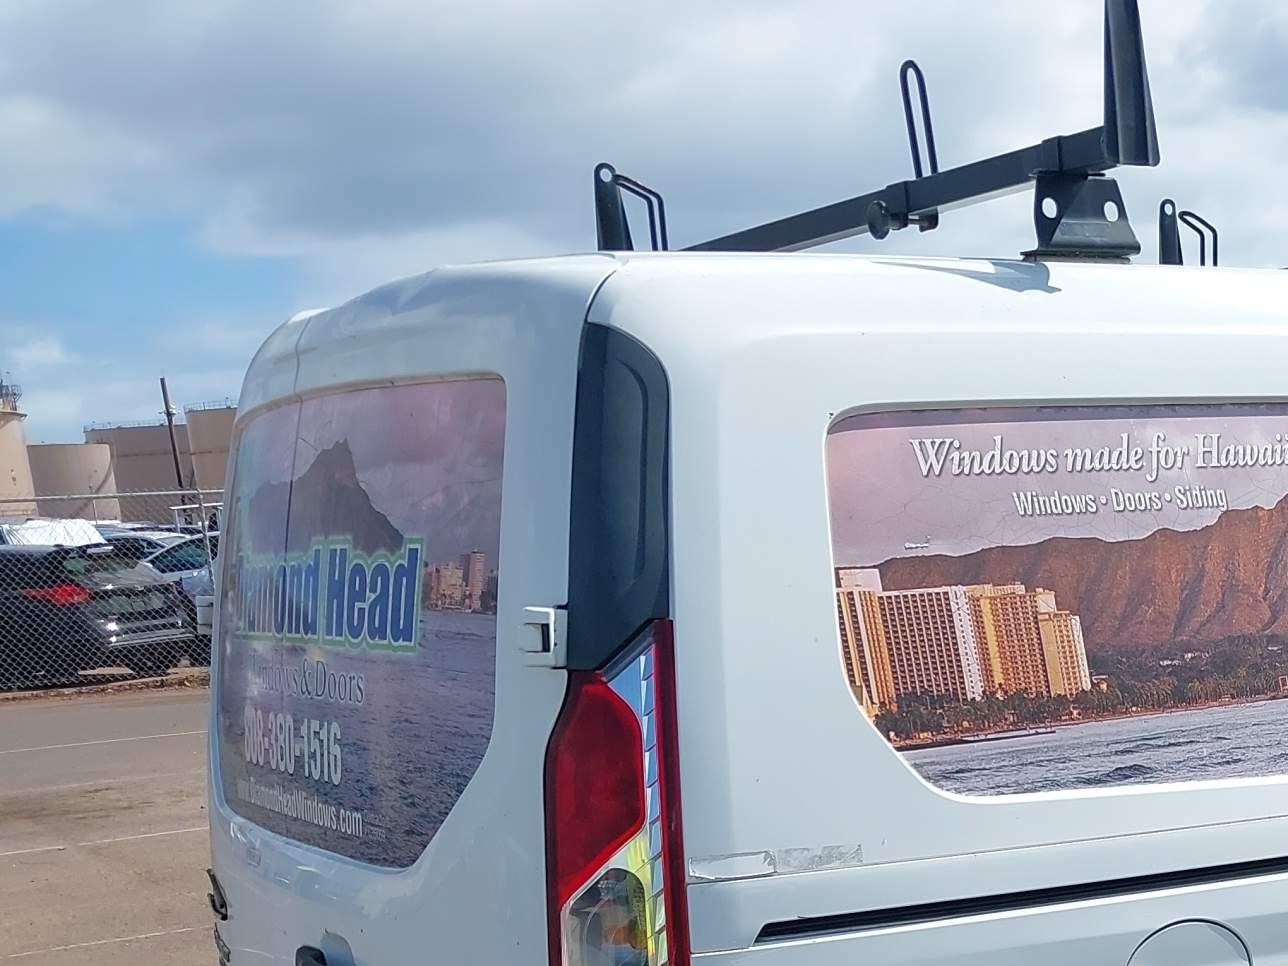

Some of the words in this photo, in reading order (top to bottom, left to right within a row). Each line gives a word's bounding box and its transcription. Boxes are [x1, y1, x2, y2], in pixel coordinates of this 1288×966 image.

[910, 436, 1058, 477] Windows
[1064, 432, 1144, 472] made
[1146, 432, 1189, 482] for
[1012, 489, 1098, 517] Windows
[1111, 487, 1163, 512] Doors
[1174, 484, 1229, 512] Siding
[235, 548, 320, 638] iamond
[323, 546, 420, 643] Head
[244, 704, 342, 786] 808-380-1516
[237, 776, 363, 838] DdHeadWindows.com
